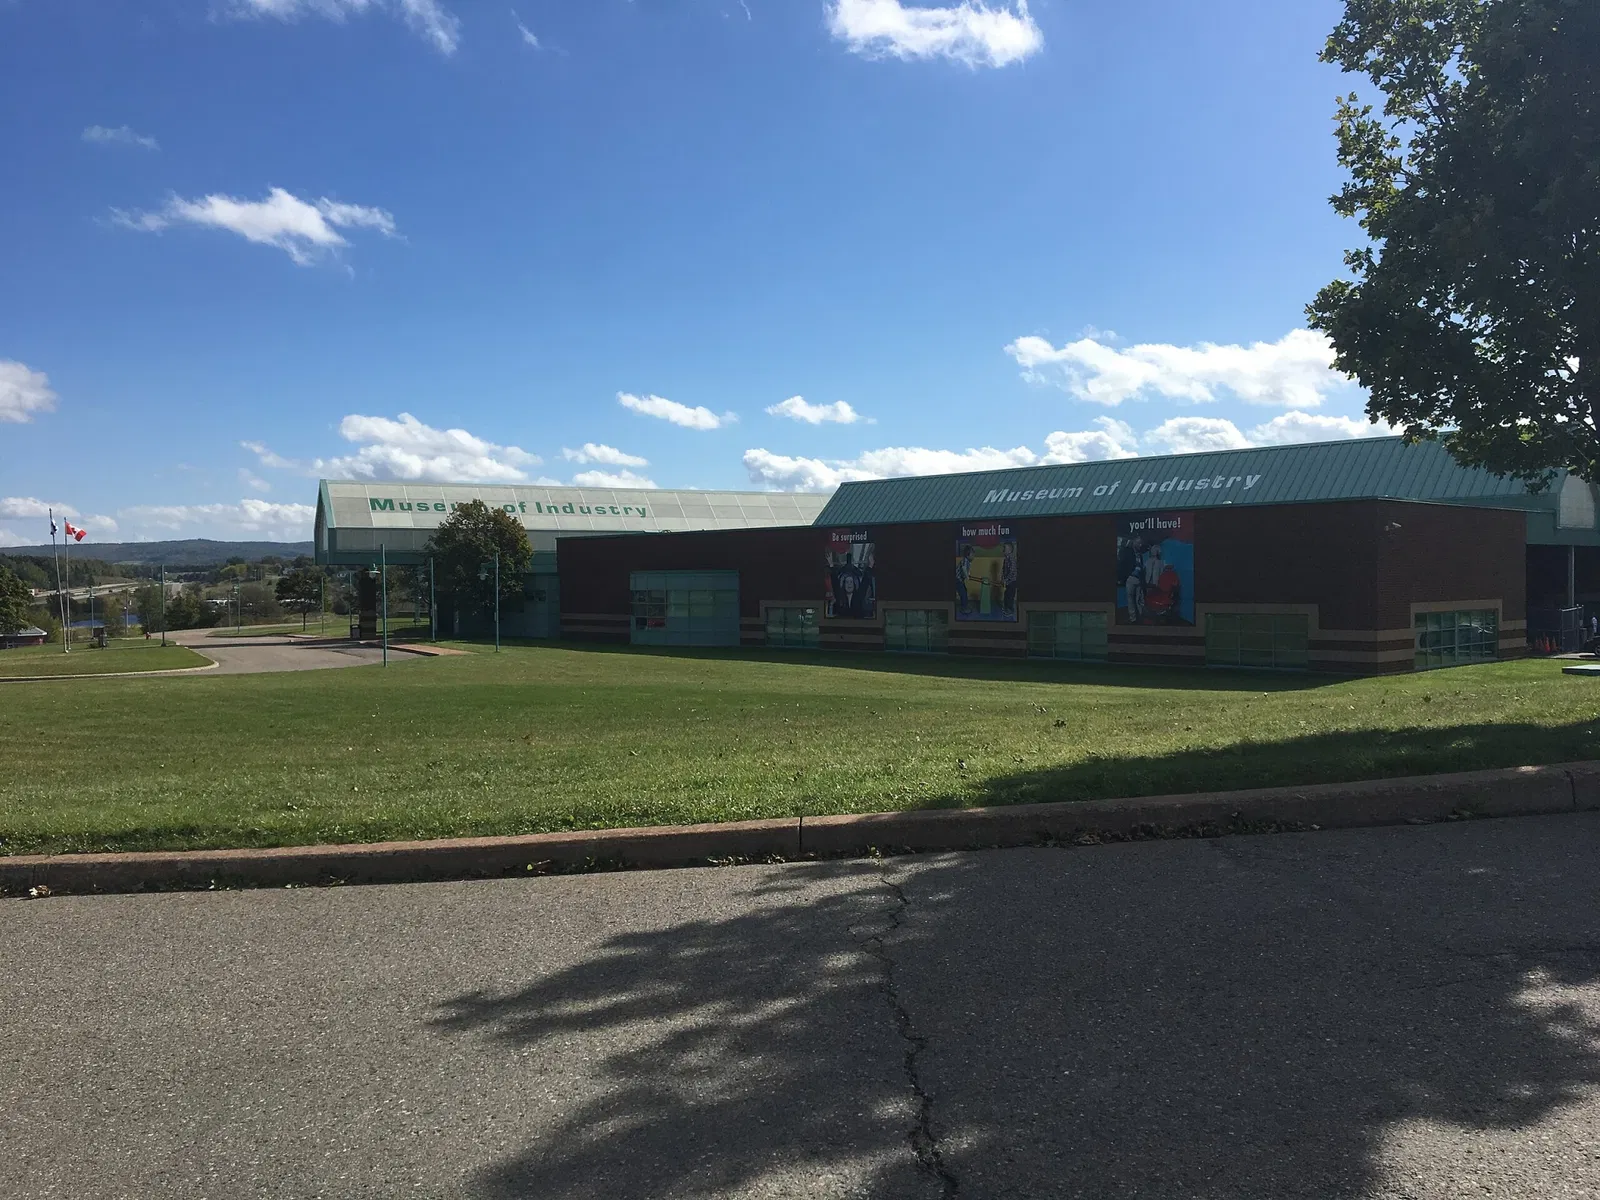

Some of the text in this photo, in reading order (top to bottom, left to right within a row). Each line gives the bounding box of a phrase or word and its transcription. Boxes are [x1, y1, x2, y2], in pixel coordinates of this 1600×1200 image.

[983, 474, 1261, 504] Museum of Industry
[370, 498, 647, 517] Muse of Industry
[962, 525, 1010, 536] how much fun
[1130, 517, 1181, 532] you'll have!
[841, 531, 867, 543] surprised
